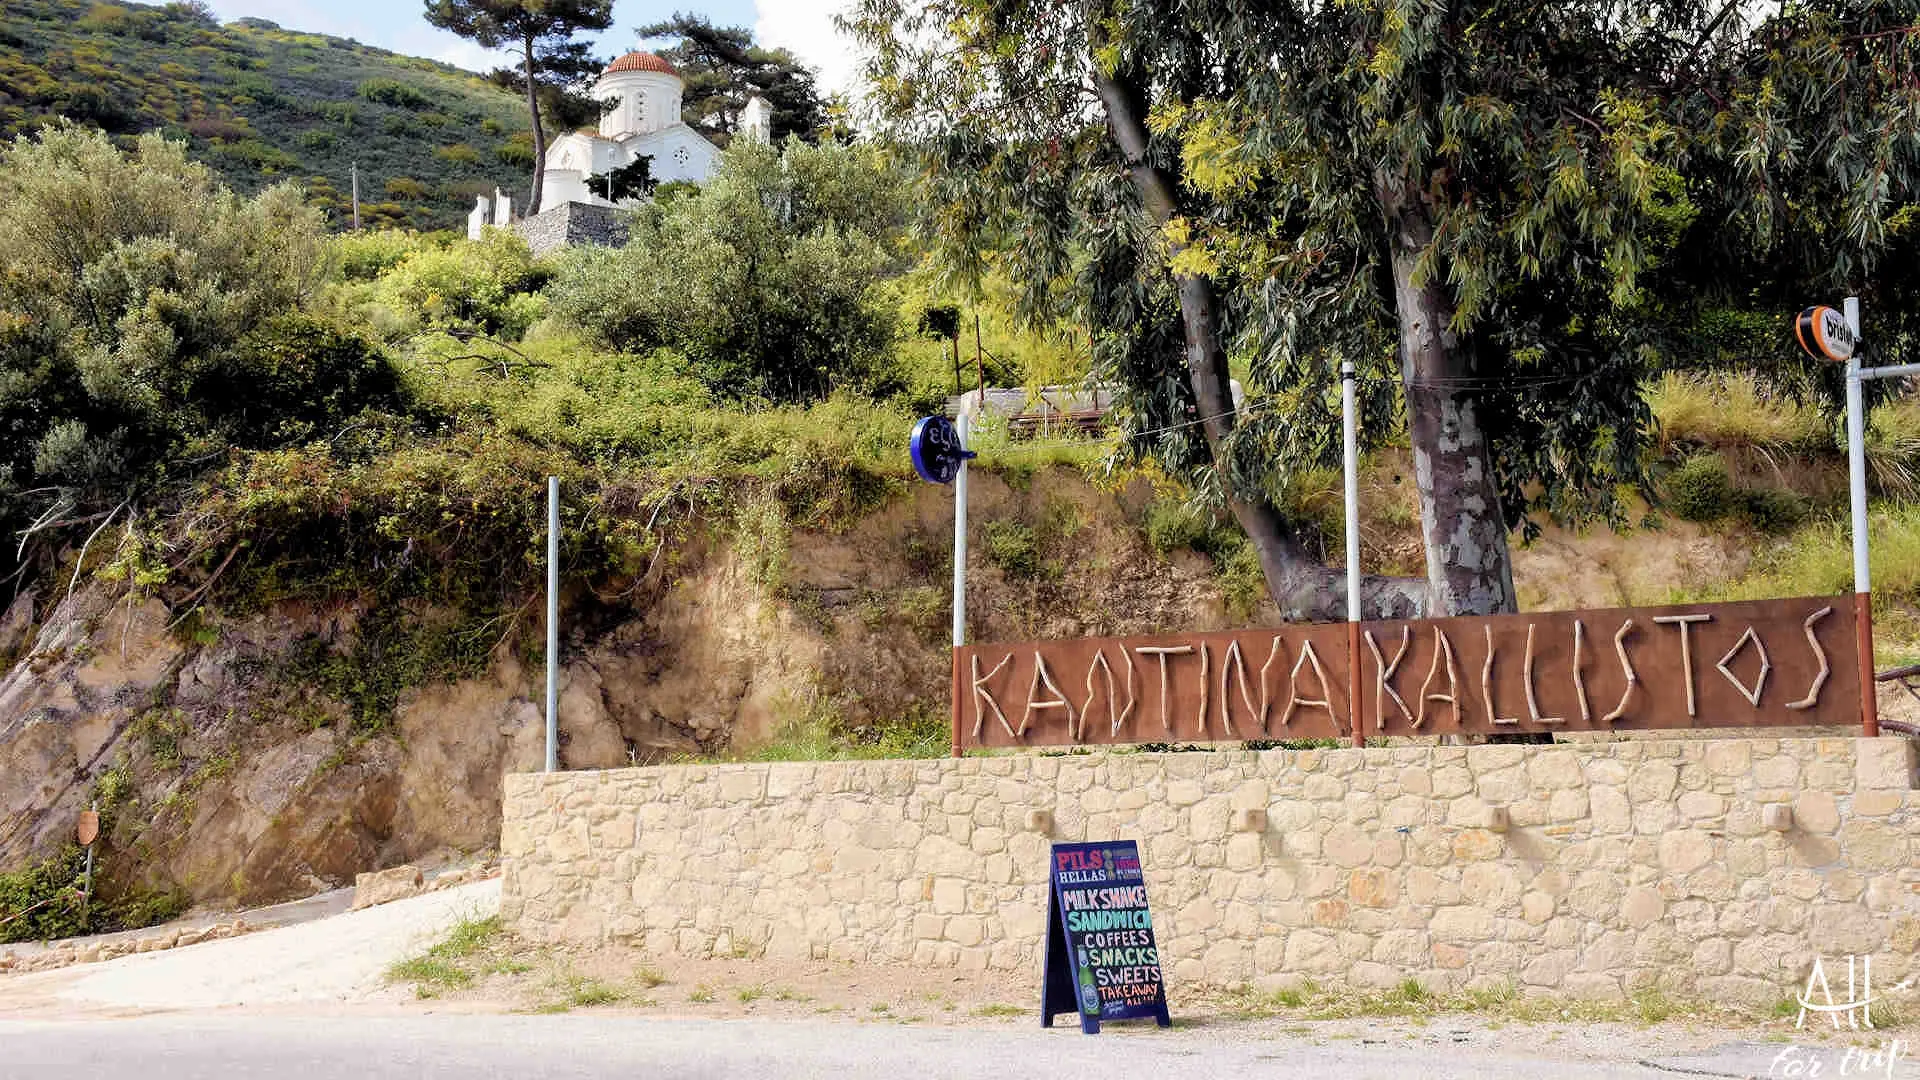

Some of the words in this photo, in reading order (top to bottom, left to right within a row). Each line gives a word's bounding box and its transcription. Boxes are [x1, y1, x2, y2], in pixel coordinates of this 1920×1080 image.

[971, 635, 1339, 741] KANTINA
[1364, 605, 1832, 729] KALLISTOS
[1056, 850, 1103, 871] PILS
[1059, 869, 1107, 883] HELLAS
[1084, 930, 1150, 948] COFFEES
[1089, 947, 1158, 966] SNACKS
[1096, 966, 1161, 985] SWEETS
[1098, 984, 1158, 1000] TAKEAWAY
